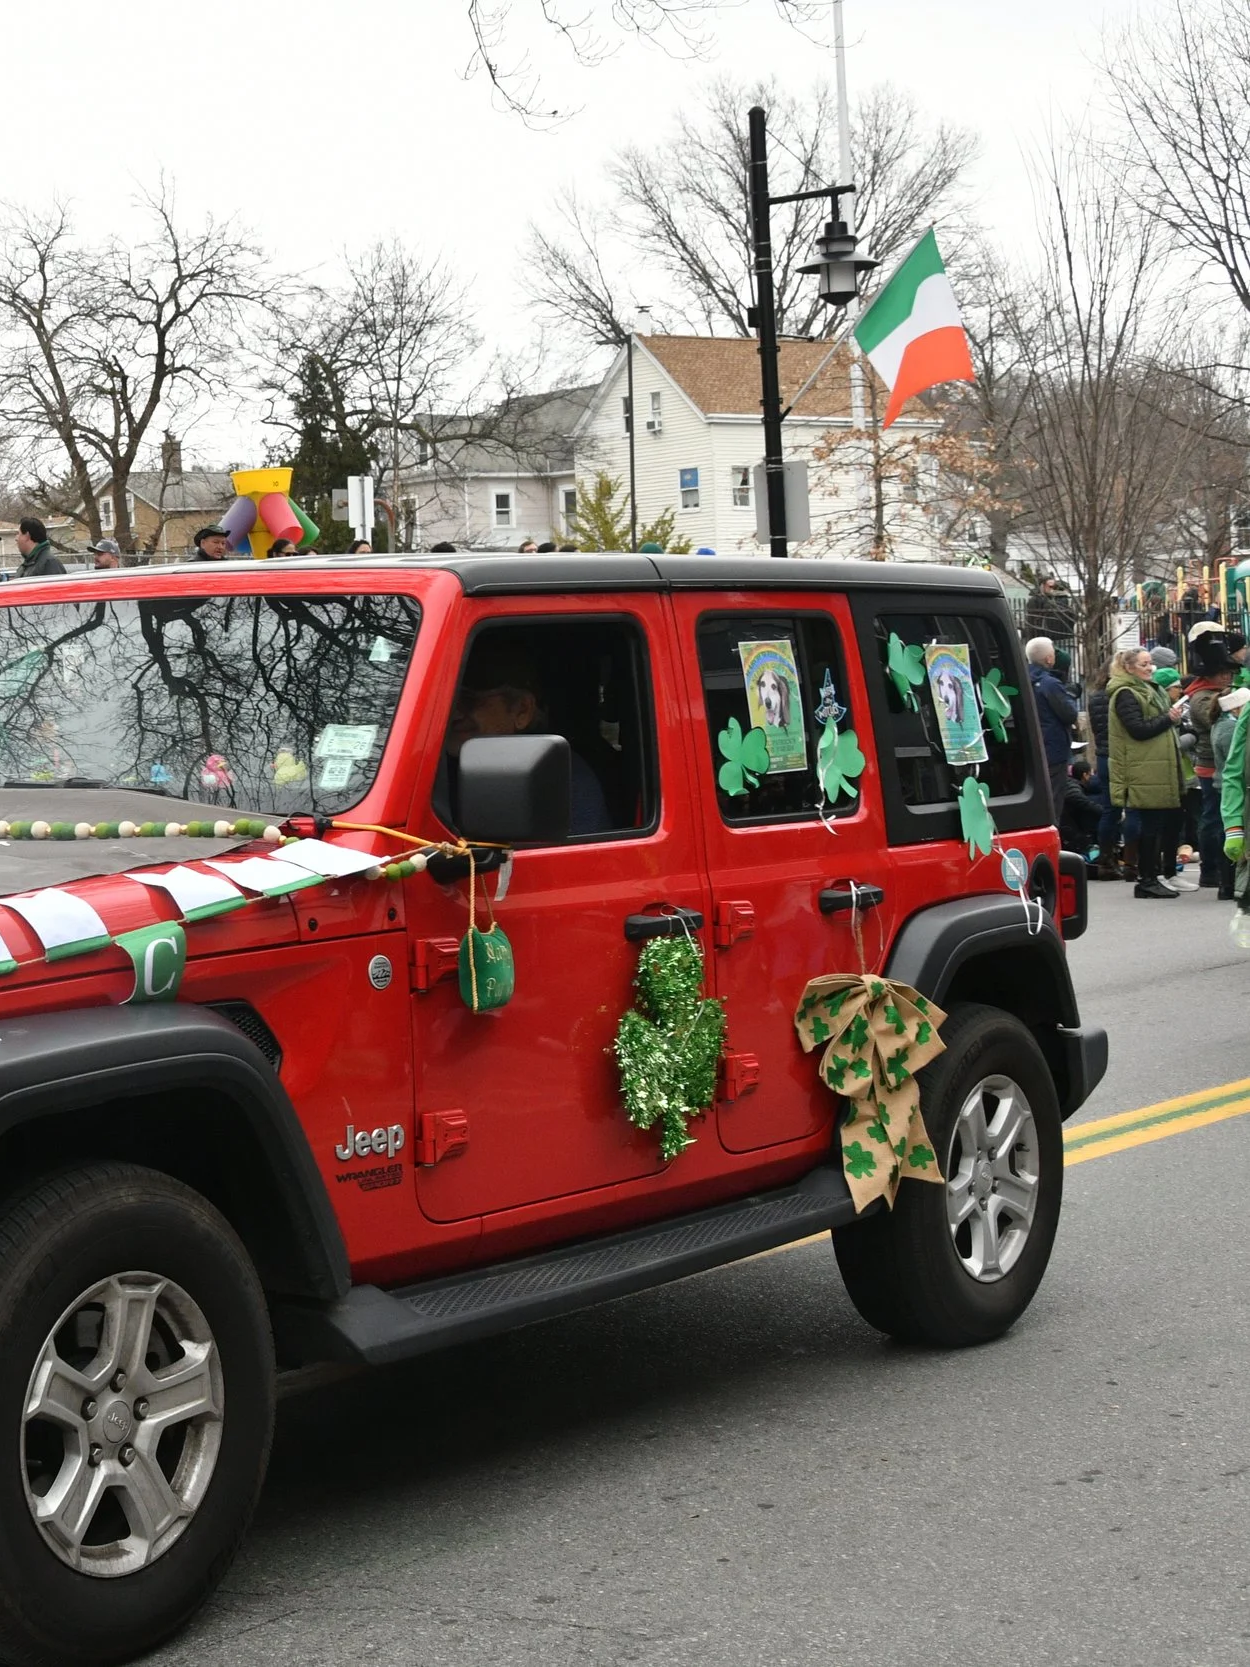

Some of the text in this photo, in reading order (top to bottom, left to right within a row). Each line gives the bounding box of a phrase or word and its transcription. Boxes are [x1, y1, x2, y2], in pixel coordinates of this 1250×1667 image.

[143, 936, 179, 997] C
[335, 1124, 405, 1160] Jeep
[335, 1163, 403, 1183] WRANGLER
[107, 1412, 128, 1431] Jeep
